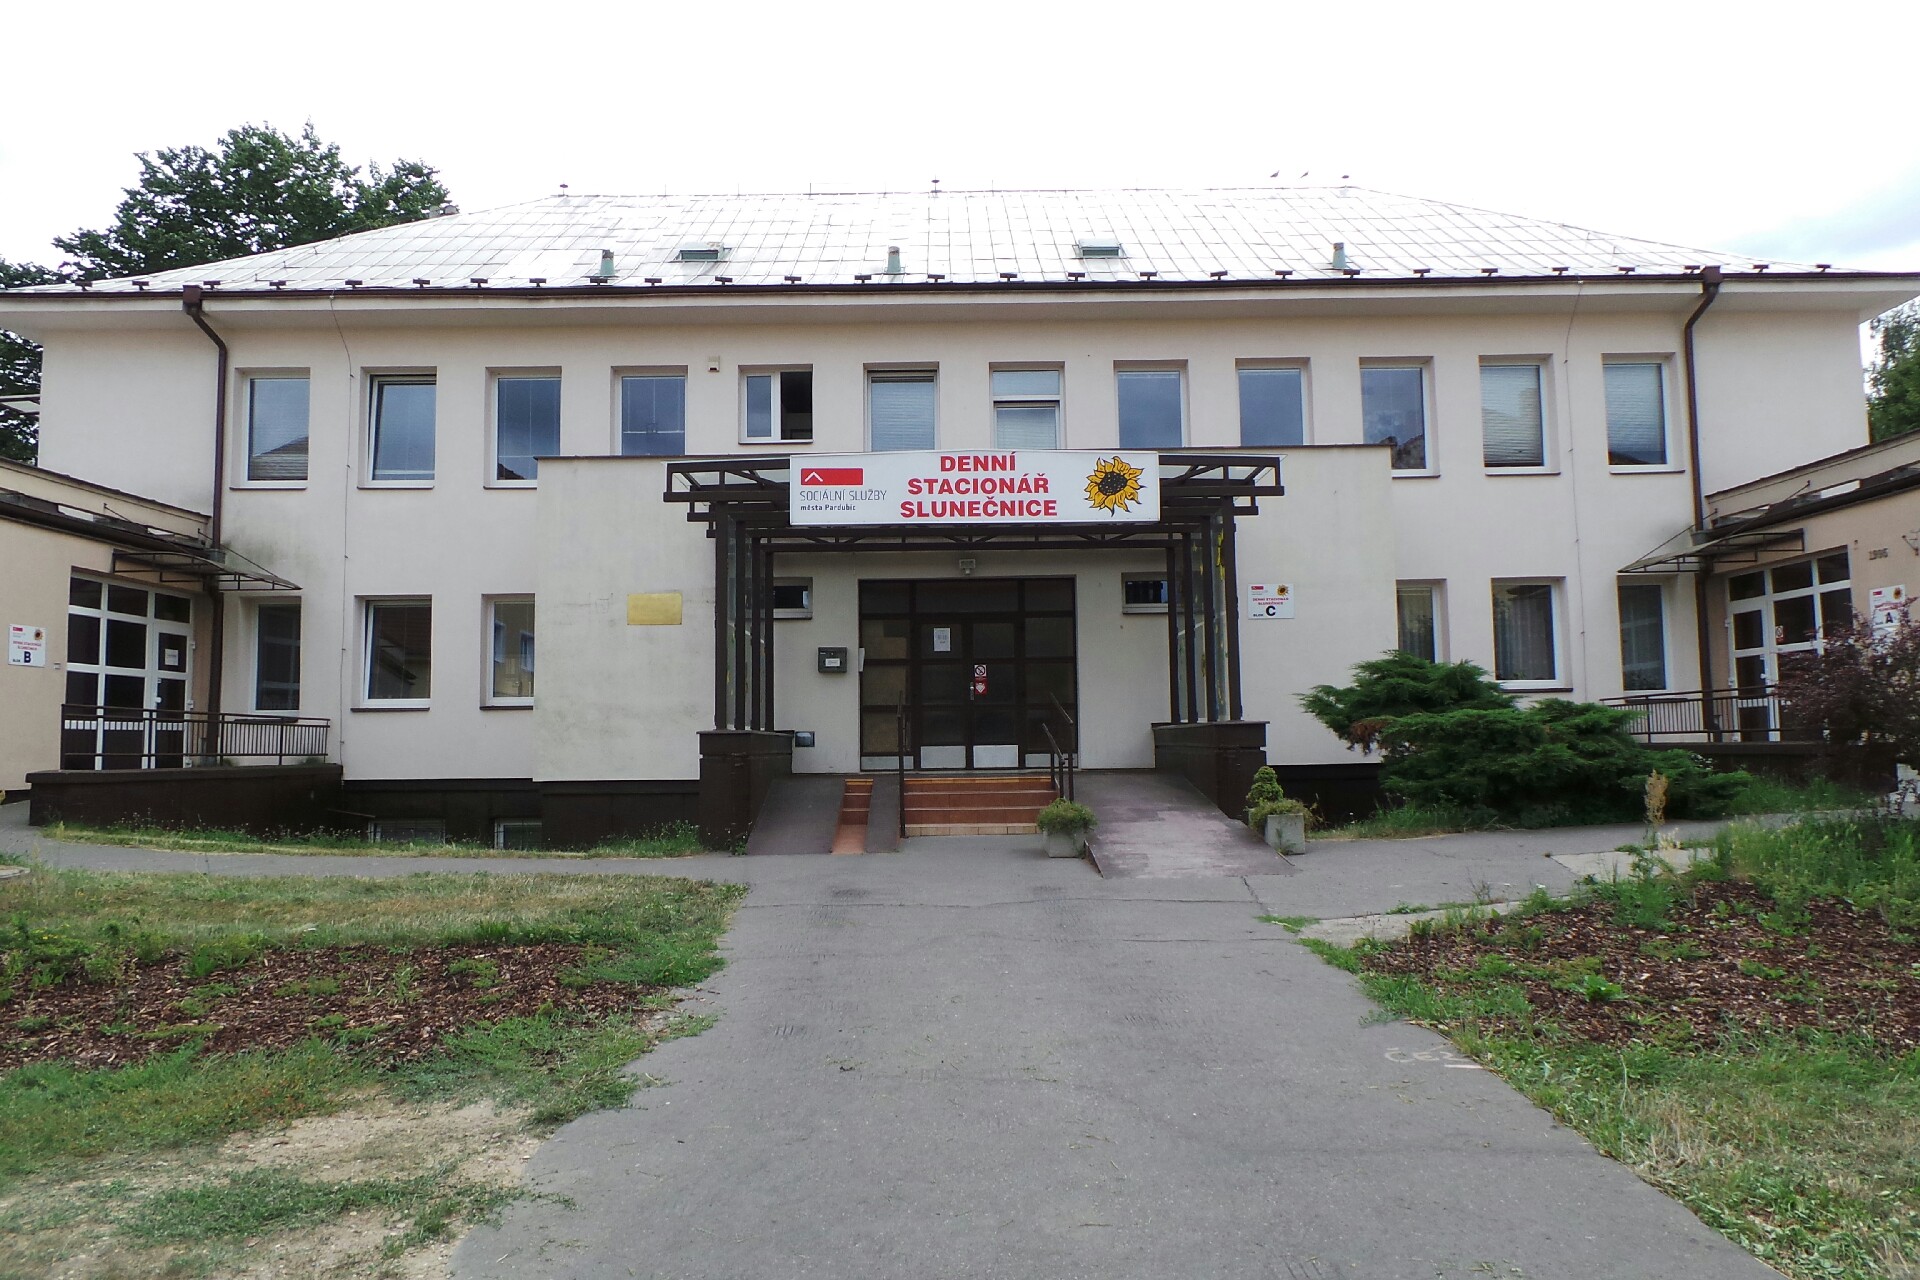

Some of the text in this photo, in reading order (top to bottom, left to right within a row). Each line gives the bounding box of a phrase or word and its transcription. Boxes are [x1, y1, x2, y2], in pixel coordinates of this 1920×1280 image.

[940, 451, 1016, 472] DENNÍ
[907, 473, 1049, 495] STACIONÁŘ
[799, 489, 887, 501] SOCIÁLNÍ SLUŽBY
[825, 503, 856, 511] Pardubic
[900, 496, 1058, 518] SLUNEČNICE
[1266, 606, 1276, 616] C
[24, 651, 31, 663] B
